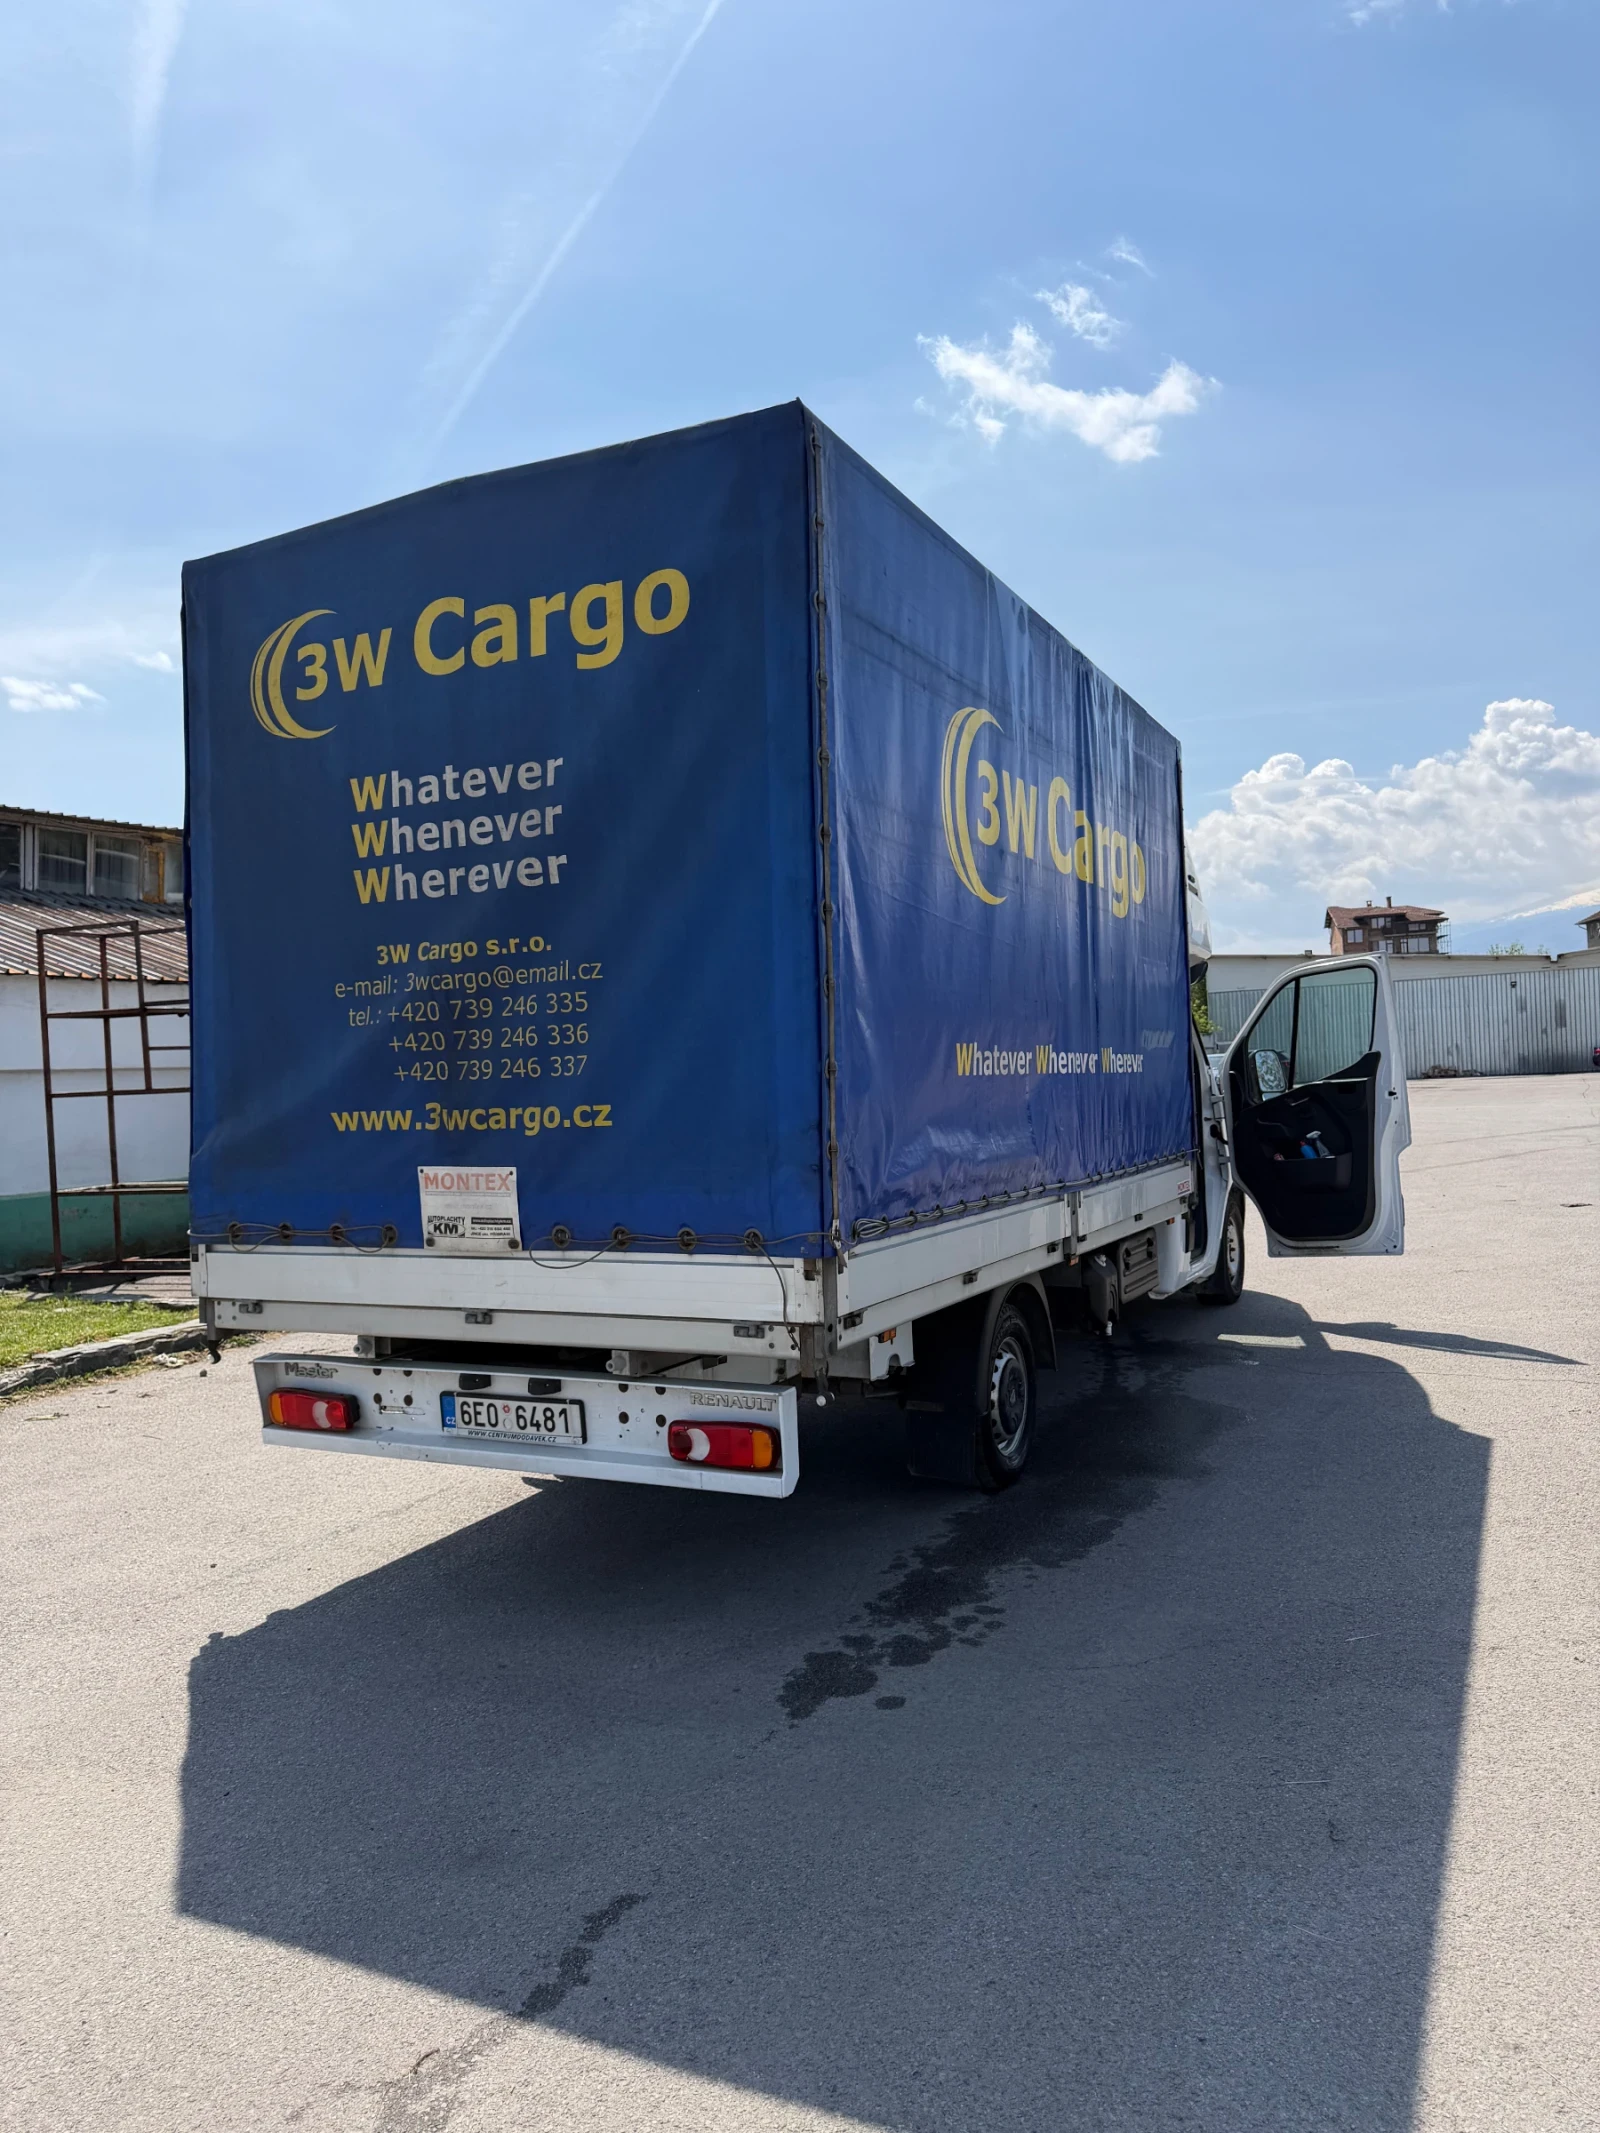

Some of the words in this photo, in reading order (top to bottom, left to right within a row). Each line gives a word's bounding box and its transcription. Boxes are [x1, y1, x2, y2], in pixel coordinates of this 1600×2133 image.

[296, 627, 393, 701] 3W
[414, 568, 690, 676] Cargo
[350, 757, 564, 812] Whatever
[351, 804, 563, 858] Whenever
[977, 758, 1038, 860] 3W
[1048, 776, 1146, 920] Cargo
[354, 853, 568, 904] Wherever
[376, 944, 411, 965] 3W
[417, 941, 478, 963] Cargo
[486, 936, 552, 955] s.r.o.
[335, 974, 398, 998] e-mail:
[404, 960, 603, 993] 3wcargo@email.cz
[348, 1005, 382, 1027] tel.:
[387, 1001, 440, 1023] +420
[450, 997, 493, 1020] 739
[501, 995, 538, 1015] 246
[546, 991, 588, 1014] 335
[389, 1031, 445, 1053] +420
[453, 1028, 493, 1050] 739
[501, 1026, 538, 1048] 246
[547, 1022, 589, 1045] 336
[394, 1060, 449, 1082] +420
[457, 1059, 493, 1080] 739
[500, 1057, 541, 1079] 246
[550, 1055, 588, 1077] 337
[956, 1042, 1033, 1076] Whatever
[1036, 1044, 1098, 1074] Whenever
[331, 1102, 613, 1136] www.3wcargo.cz
[424, 1172, 511, 1191] MONTEX
[433, 1222, 459, 1235] KM
[284, 1362, 338, 1378] Master
[690, 1391, 777, 1412] RENAULT
[445, 1416, 456, 1425] CZ
[515, 1405, 569, 1434] 6481
